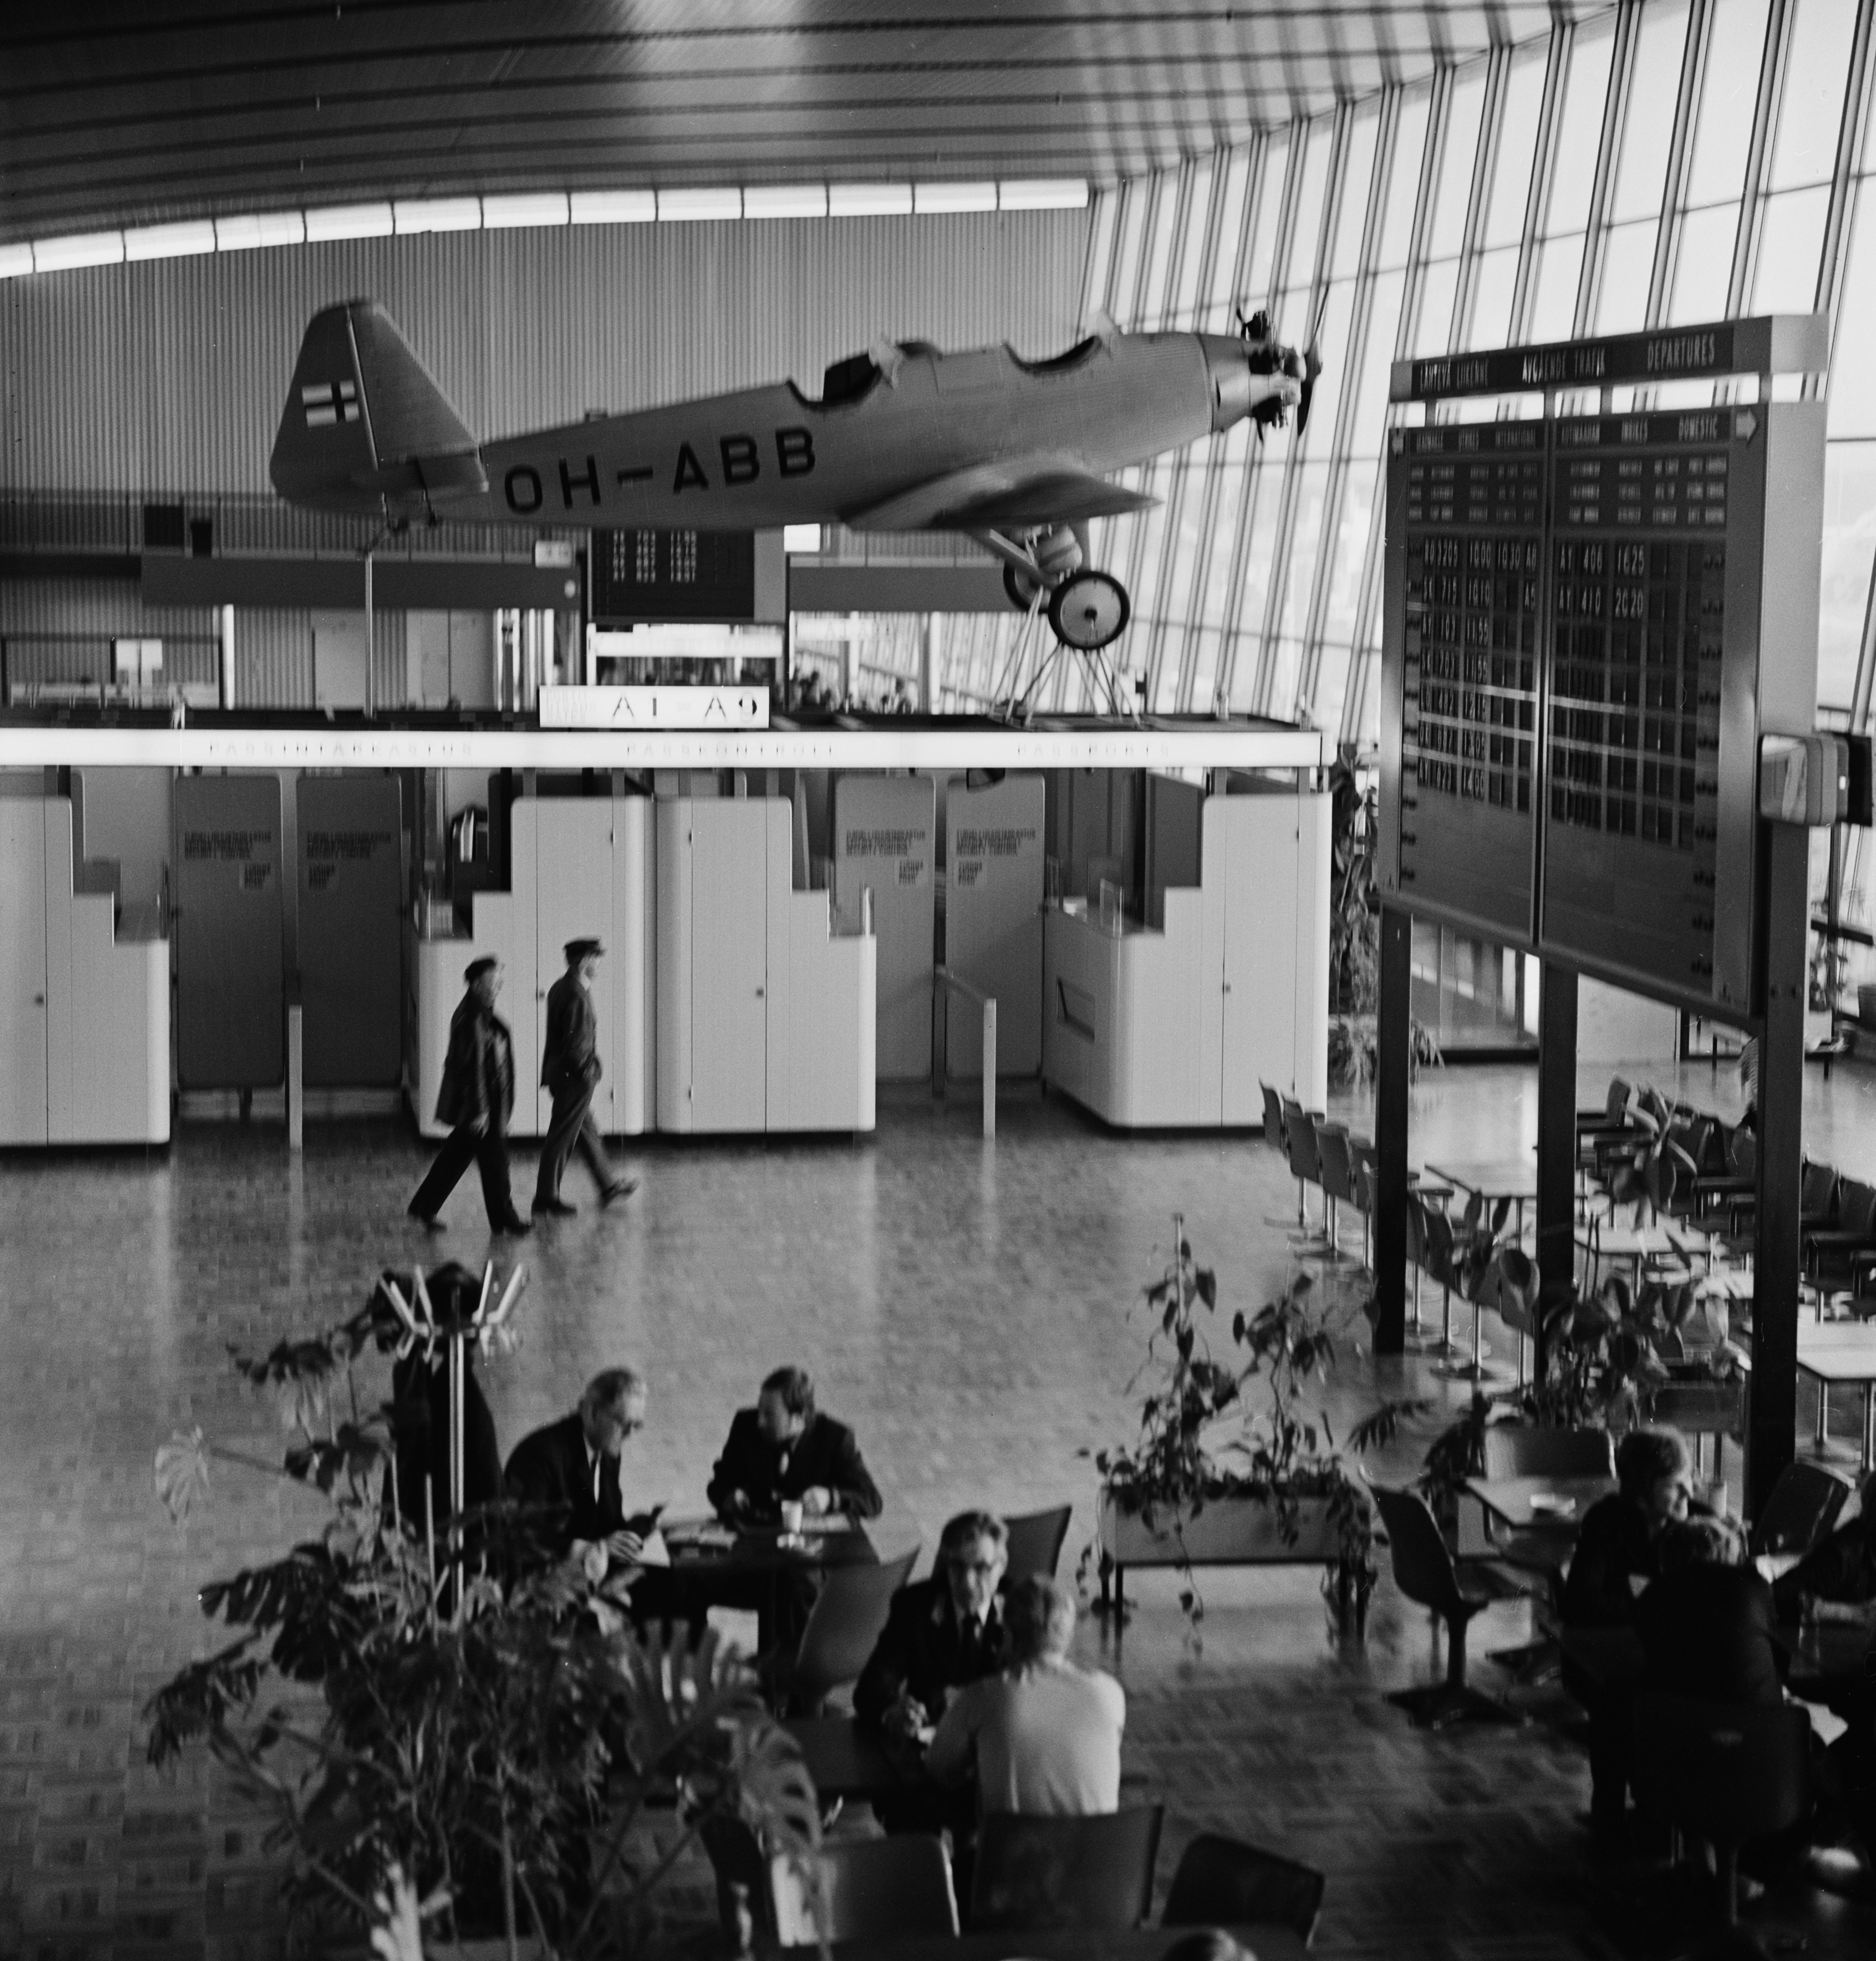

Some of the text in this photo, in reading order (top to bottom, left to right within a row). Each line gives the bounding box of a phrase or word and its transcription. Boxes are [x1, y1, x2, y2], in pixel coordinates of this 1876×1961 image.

[1647, 333, 1715, 372] DEPARTURES
[504, 425, 816, 514] OH-ABB
[1560, 544, 1645, 576] AY 406 1625
[1468, 577, 1490, 607] 1010
[1559, 585, 1644, 619] AY 410 2020
[611, 693, 657, 724] A1
[703, 691, 758, 724] A9
